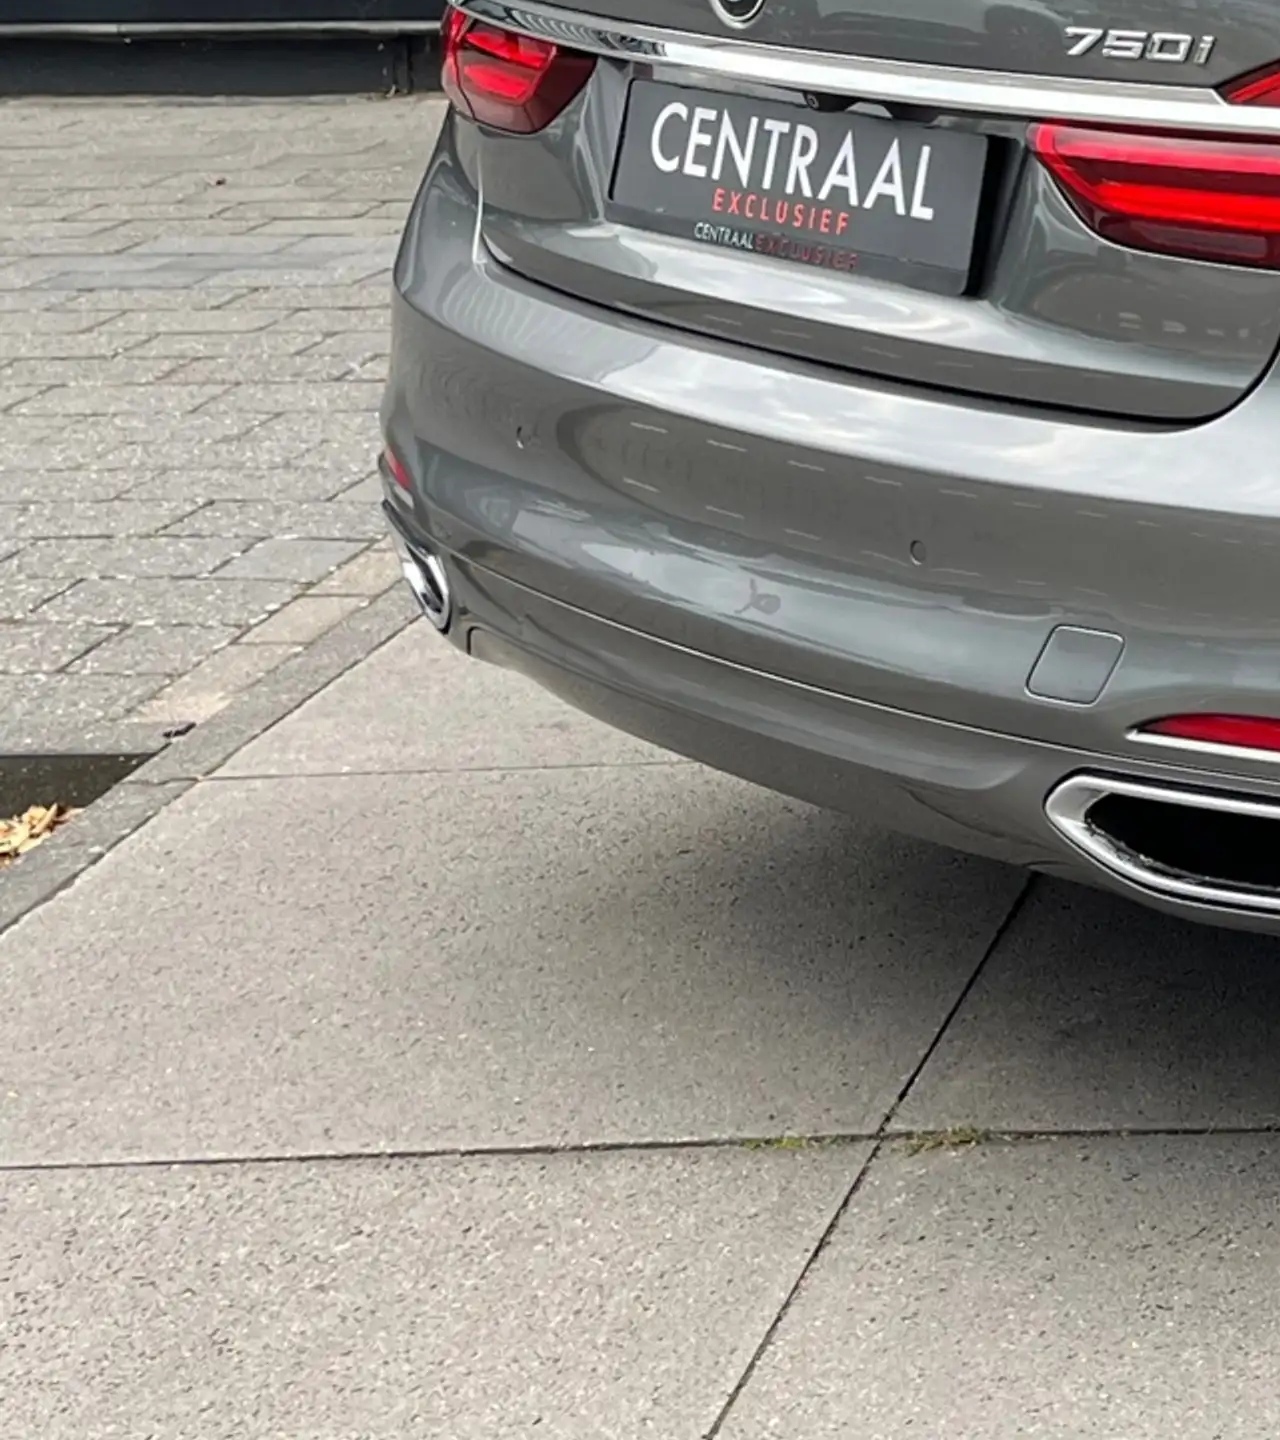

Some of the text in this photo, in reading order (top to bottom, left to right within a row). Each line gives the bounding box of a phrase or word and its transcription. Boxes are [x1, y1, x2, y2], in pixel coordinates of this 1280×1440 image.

[1064, 25, 1216, 66] 750i
[650, 102, 935, 221] CENTRAAL
[711, 187, 850, 236] EXCLUSIEF
